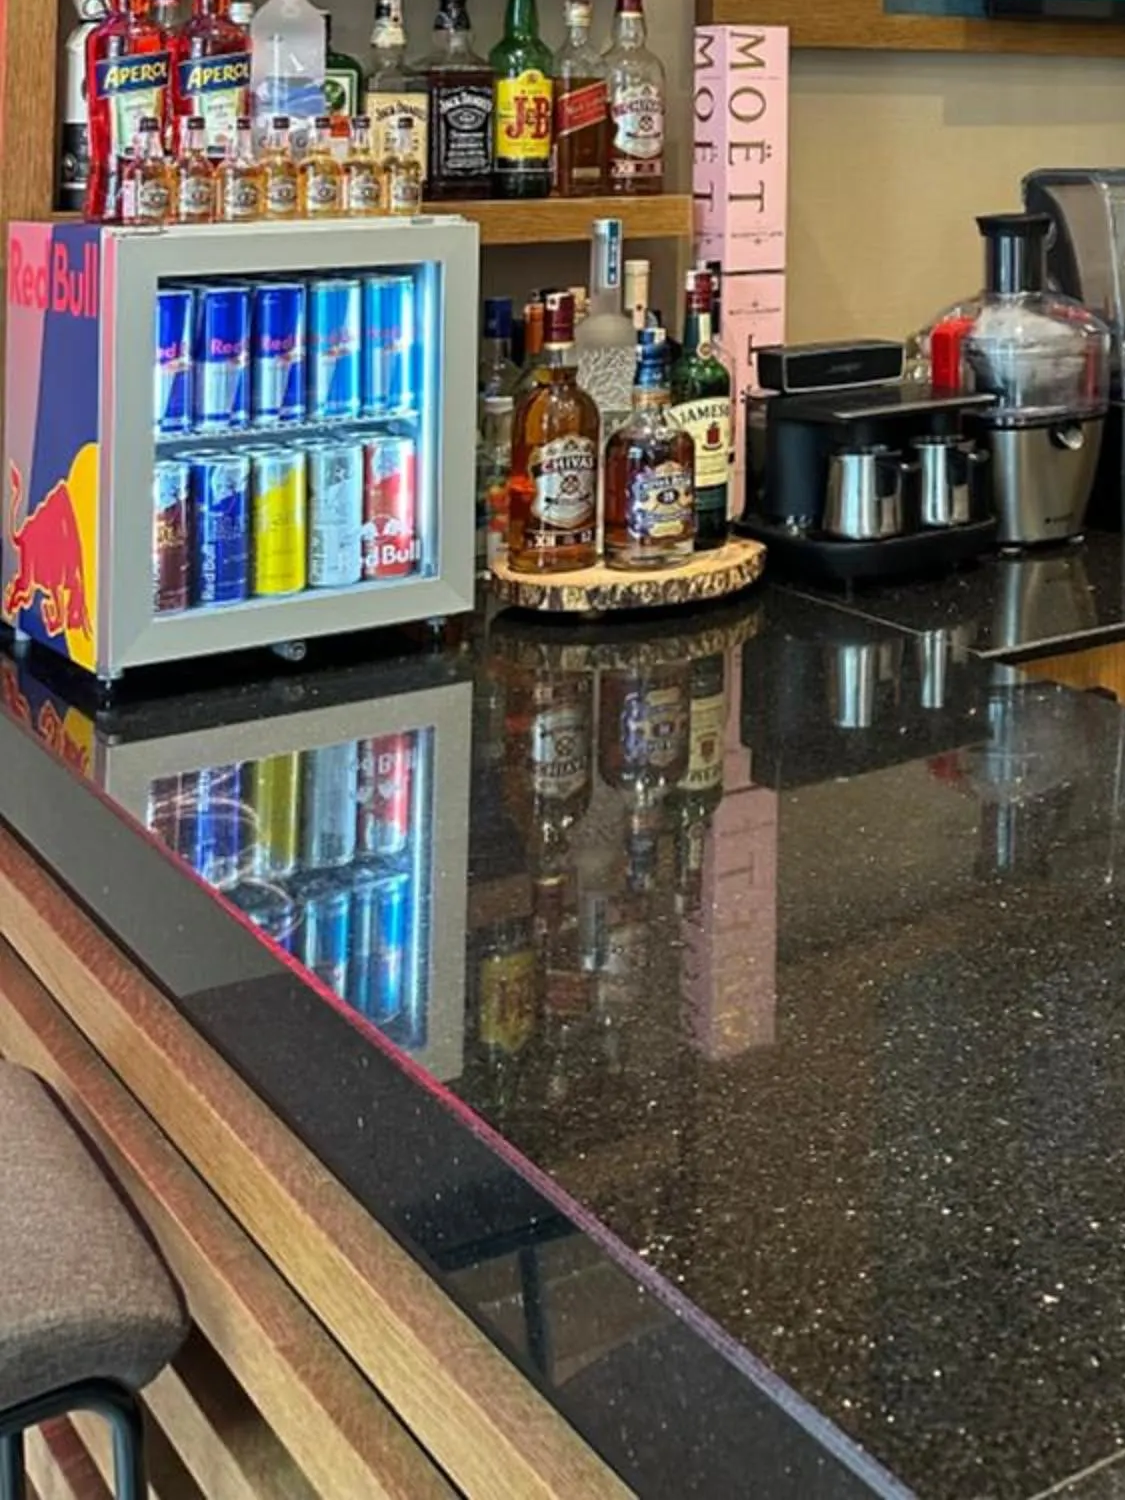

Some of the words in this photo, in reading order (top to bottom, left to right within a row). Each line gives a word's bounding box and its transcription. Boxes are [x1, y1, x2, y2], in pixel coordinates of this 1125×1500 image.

[728, 32, 772, 213] MOËT
[10, 237, 53, 310] Red
[54, 242, 98, 318] Bull
[382, 538, 420, 566] Bull
